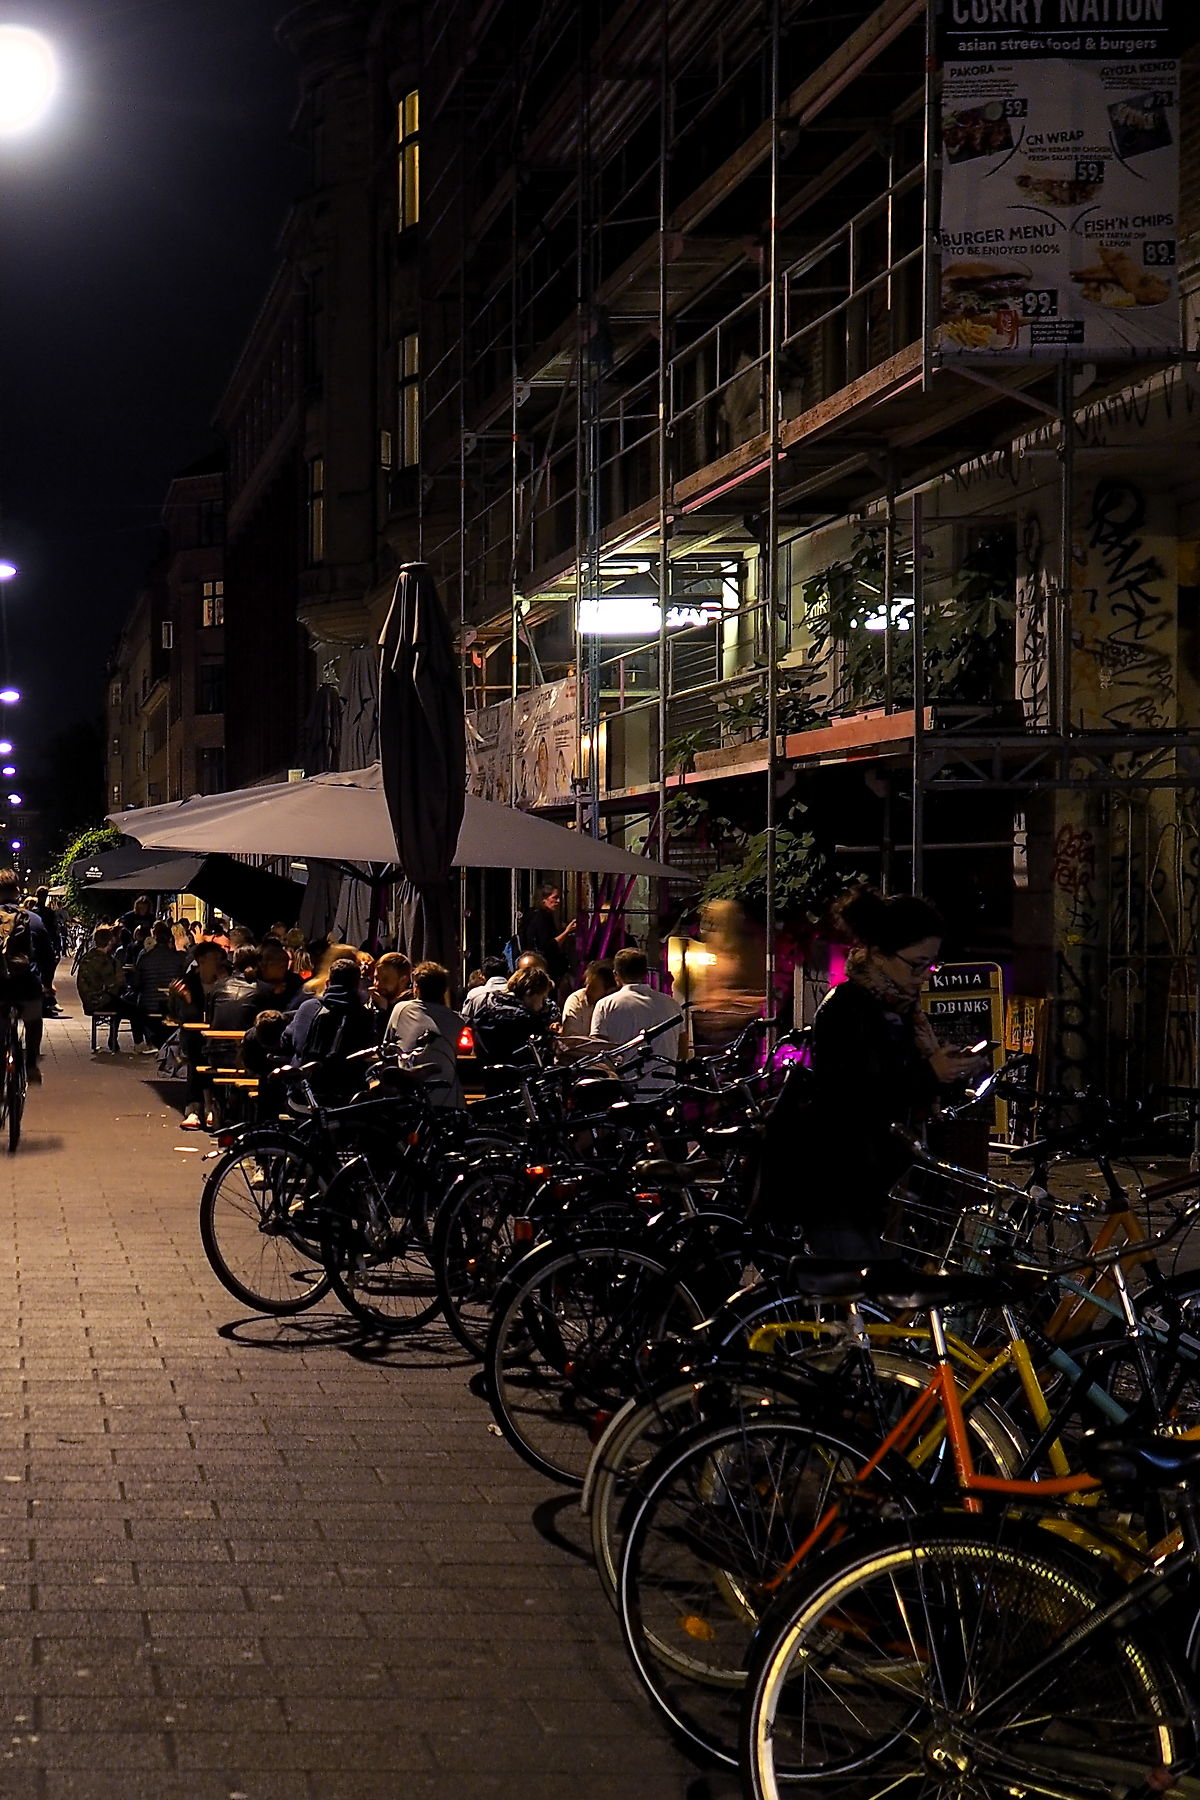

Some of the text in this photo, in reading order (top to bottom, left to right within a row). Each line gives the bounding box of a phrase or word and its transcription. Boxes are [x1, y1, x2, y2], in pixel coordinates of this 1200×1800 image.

[958, 37, 997, 51] asian
[1046, 37, 1081, 51] food
[1085, 37, 1098, 51] &
[1100, 35, 1158, 53] burgers
[950, 64, 994, 78] PAKORA
[1026, 130, 1084, 146] CN WRAP
[1084, 213, 1174, 232] FISH'N CHIPS
[942, 223, 1056, 247] BURGER MENU
[951, 244, 1060, 256] TO BE ENJOYED 100%
[932, 973, 983, 988] KIMIA
